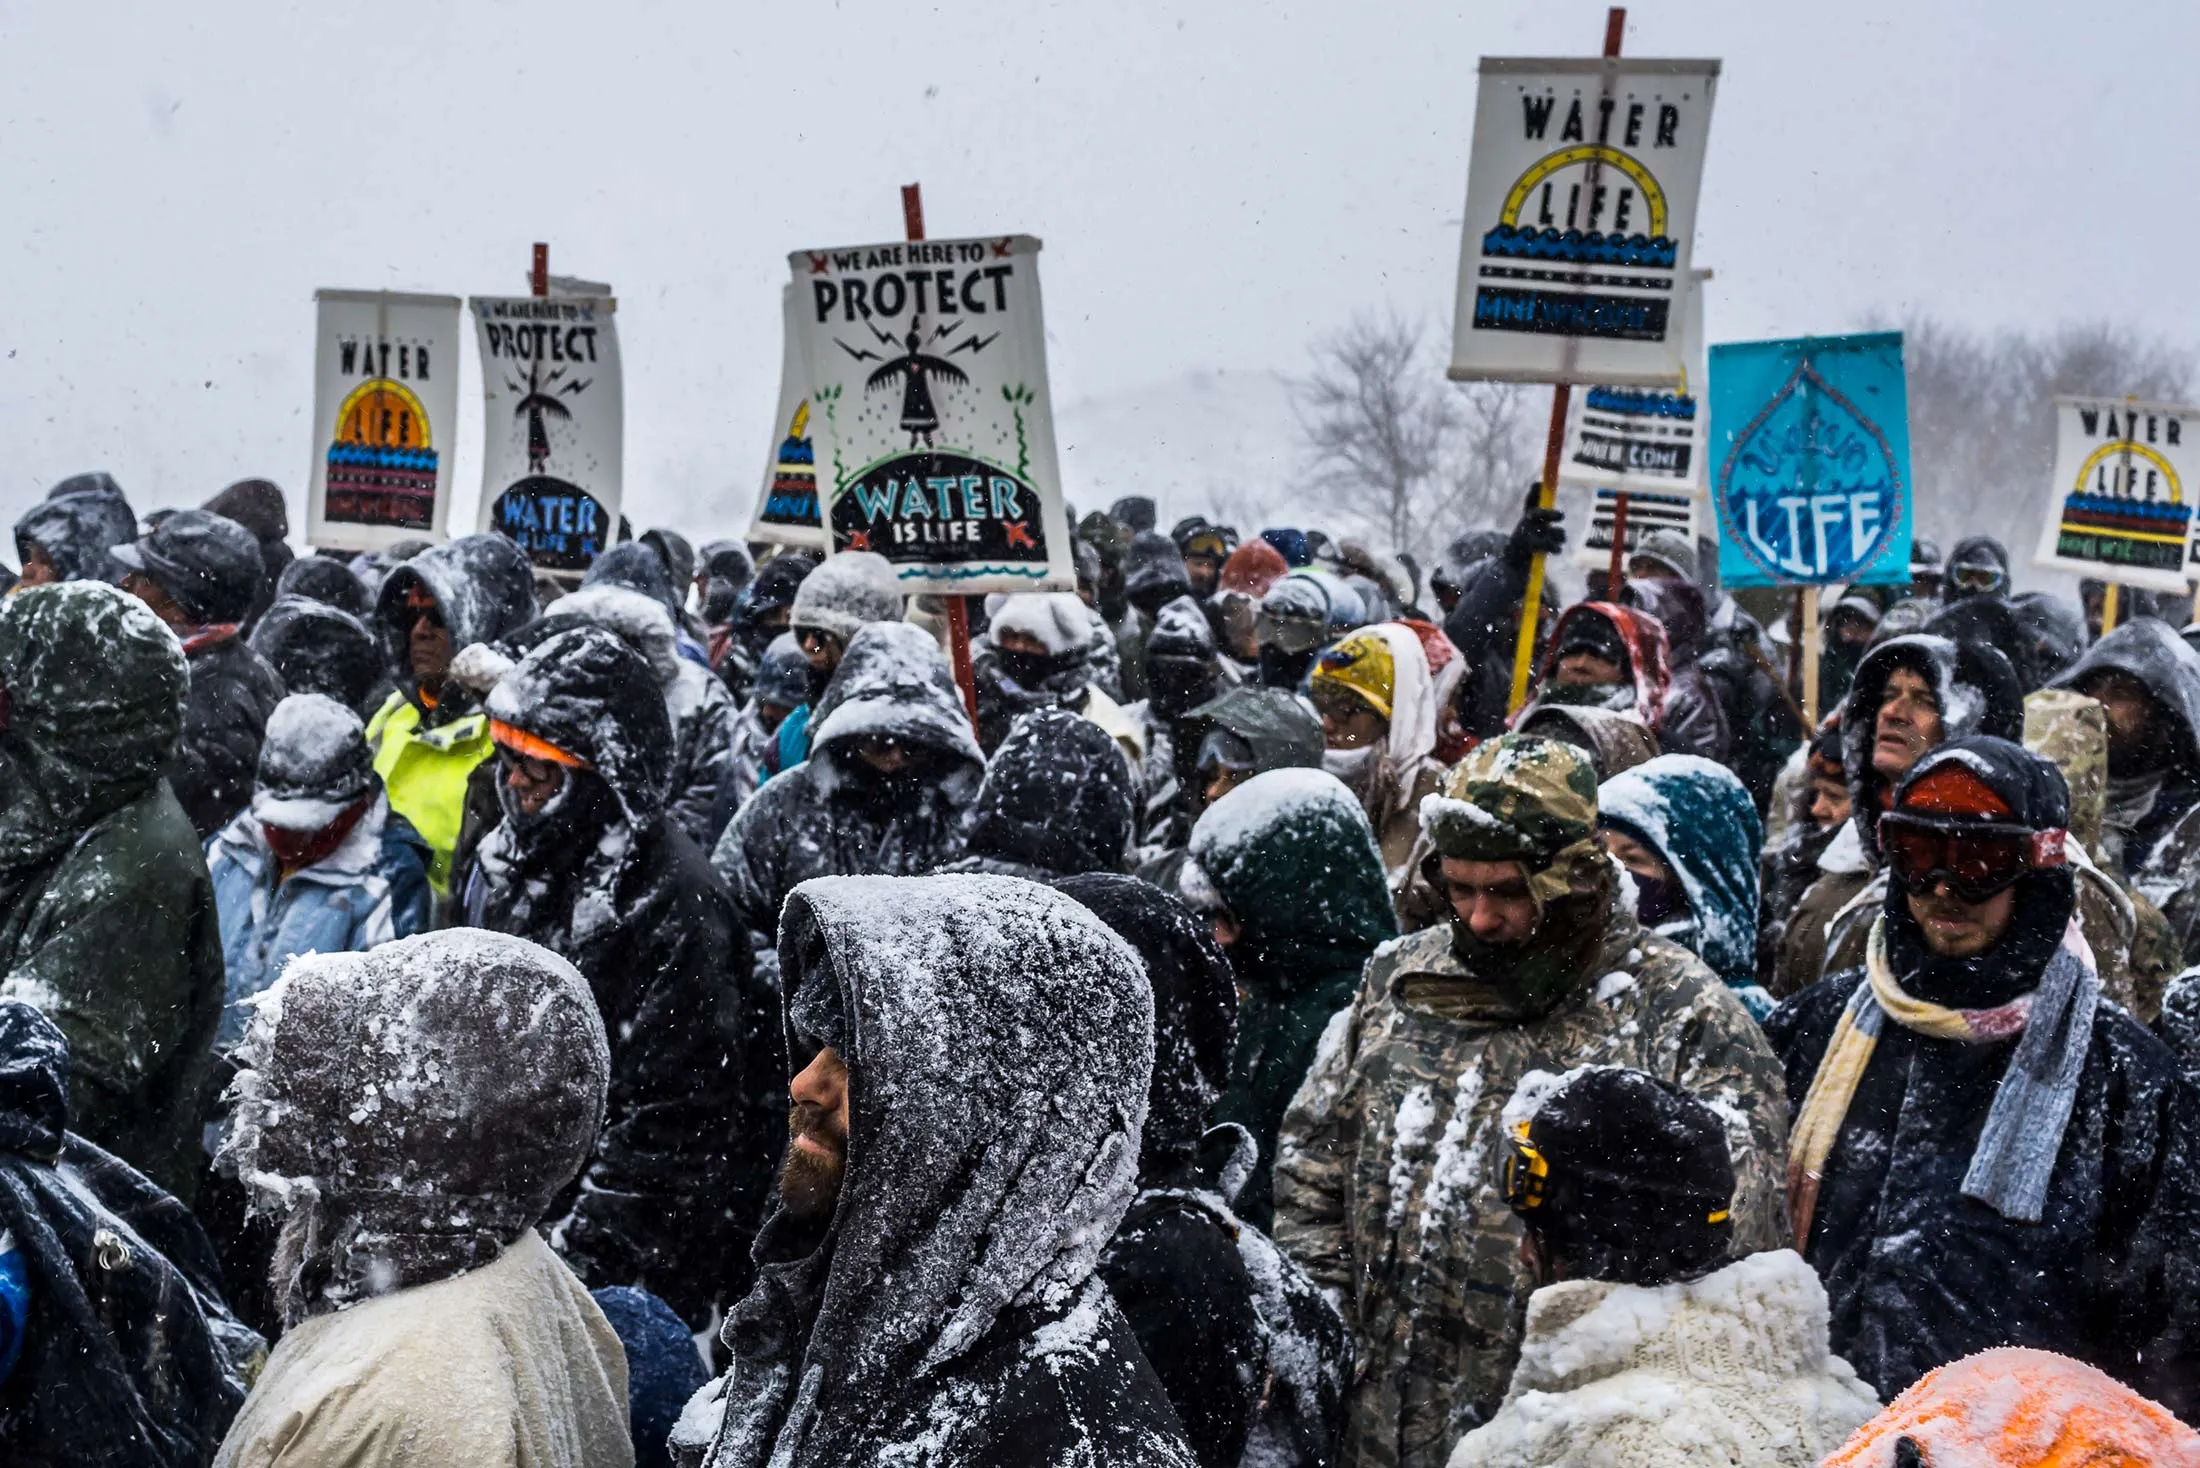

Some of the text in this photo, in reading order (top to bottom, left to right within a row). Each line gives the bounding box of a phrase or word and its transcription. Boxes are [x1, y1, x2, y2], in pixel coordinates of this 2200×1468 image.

[1522, 96, 1679, 148] WATER
[1538, 181, 1634, 231] LIFE
[832, 243, 986, 272] WE ARE HERE TO
[813, 264, 1013, 323] PROTECT
[340, 340, 429, 381] WATER
[485, 322, 597, 362] PROTECT
[354, 406, 410, 444] LIFE
[2080, 407, 2182, 446] WATER
[853, 474, 1024, 525] WATER
[2097, 464, 2157, 499] LIFE
[503, 492, 598, 535] WATER
[893, 520, 982, 543] IS LIFE
[1746, 491, 1881, 576] LIFE
